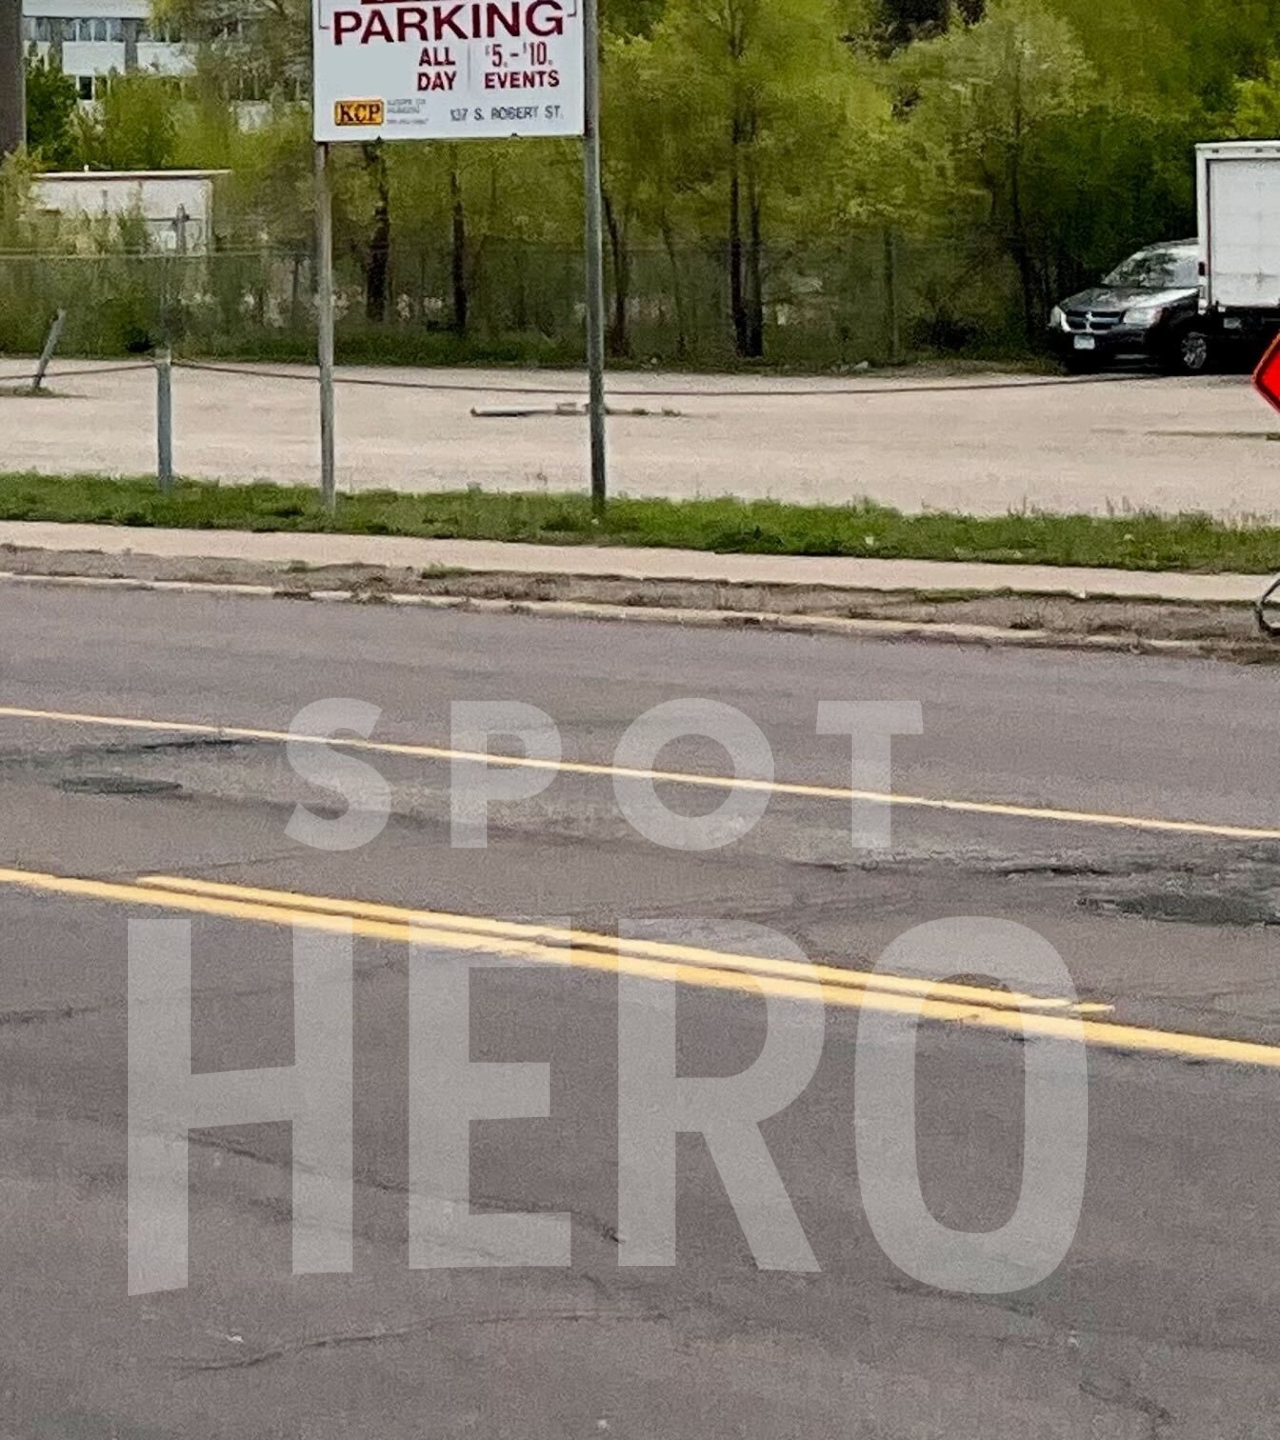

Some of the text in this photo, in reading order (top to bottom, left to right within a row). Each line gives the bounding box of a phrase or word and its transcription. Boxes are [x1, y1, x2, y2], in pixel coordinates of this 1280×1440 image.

[418, 46, 456, 67] ALL
[417, 70, 457, 92] DAY
[484, 69, 560, 90] EVENTS
[341, 103, 380, 123] KCP
[491, 106, 539, 120] ROBERT
